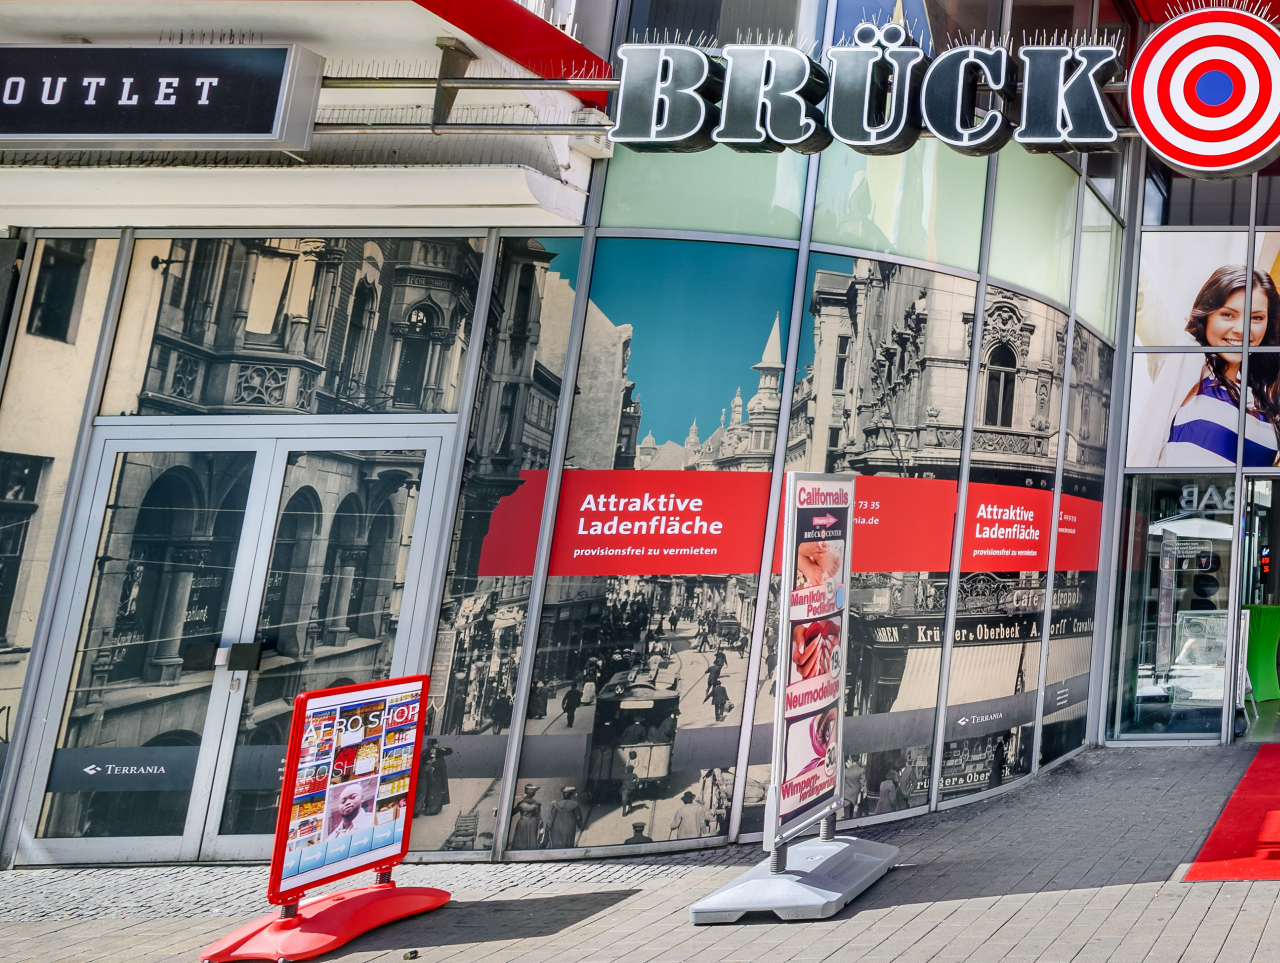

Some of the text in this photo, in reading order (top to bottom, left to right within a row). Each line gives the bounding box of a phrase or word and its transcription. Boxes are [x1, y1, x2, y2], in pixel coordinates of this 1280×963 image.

[2, 76, 219, 105] OUTLET
[607, 22, 1121, 145] BRÜCK
[580, 492, 703, 512] Attraktive
[976, 503, 1034, 521] Attraktive
[577, 516, 723, 535] Ladenfläche
[975, 522, 1040, 540] Ladenfläche
[573, 546, 718, 558] provisionsfrei zu vermieten
[973, 547, 1011, 557] provisionsfrei
[1017, 548, 1038, 557] vermieten
[916, 624, 969, 643] Krüer
[976, 622, 1021, 640] Oberbeck
[1049, 618, 1067, 635] orff
[302, 704, 420, 743] AFRO SHOP
[966, 766, 1011, 783] Oberck
